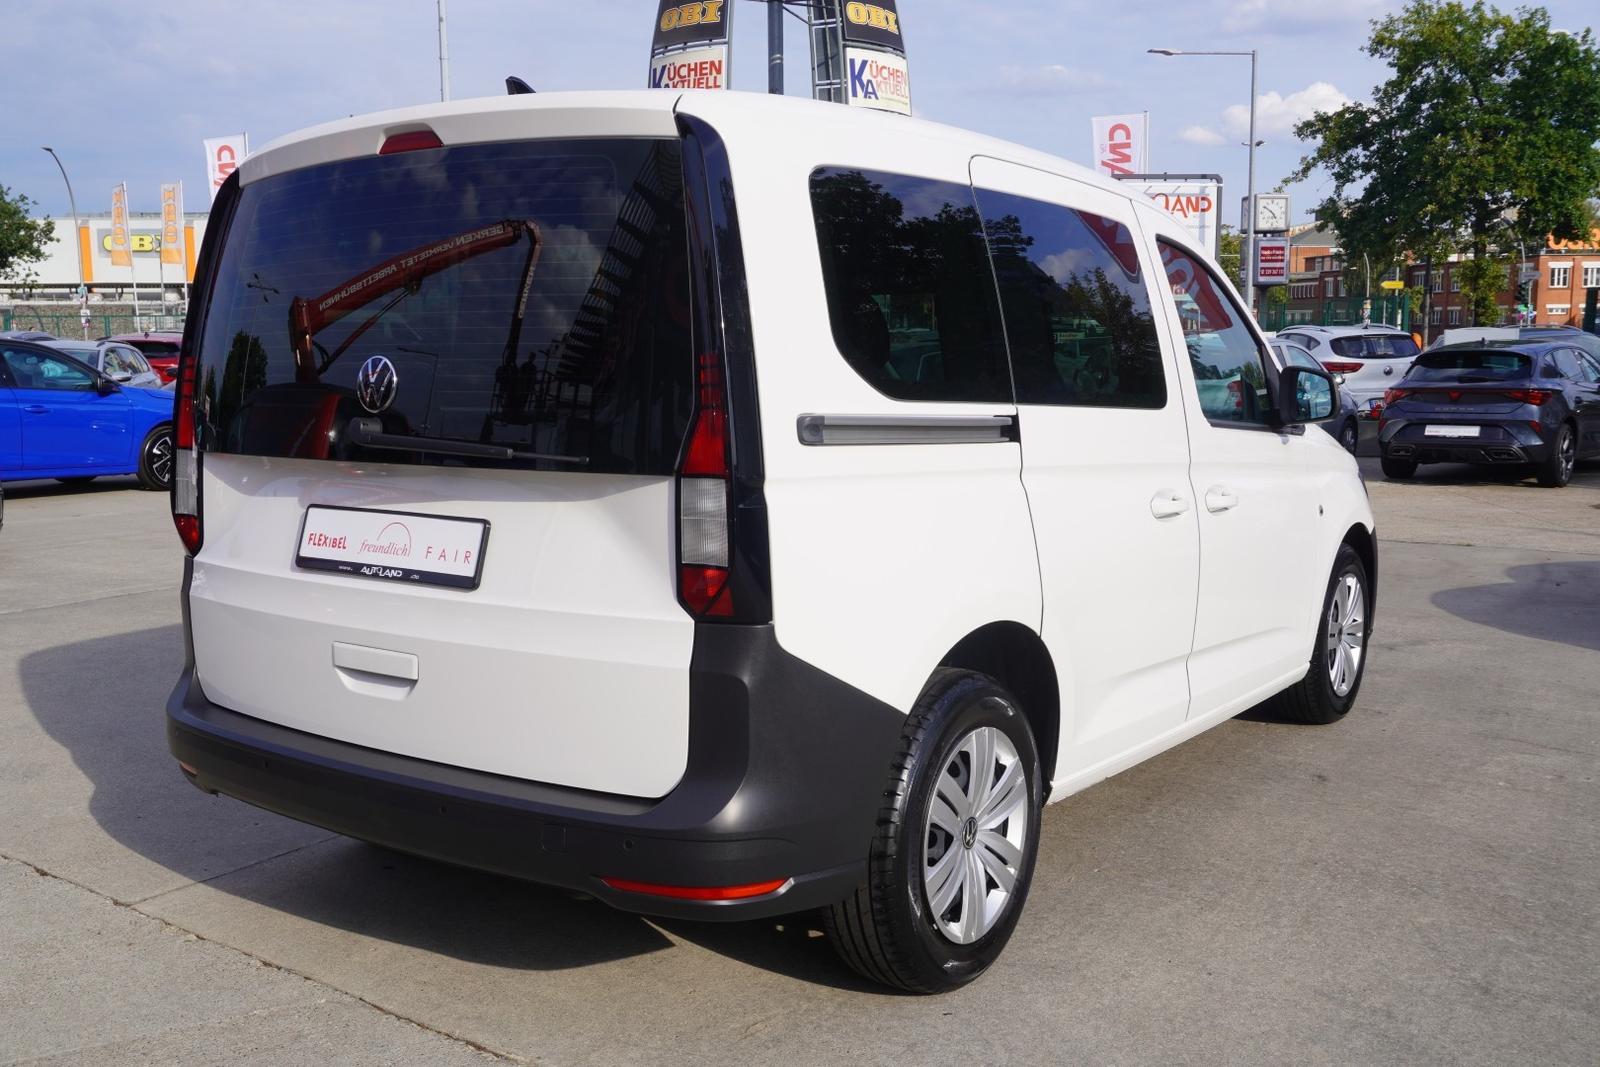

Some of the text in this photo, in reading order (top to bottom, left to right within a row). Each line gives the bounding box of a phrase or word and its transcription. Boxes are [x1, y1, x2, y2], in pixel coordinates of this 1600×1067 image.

[661, 0, 723, 31] OBI
[846, 2, 899, 34] OBI
[652, 60, 722, 88] KÜCHEN
[849, 58, 907, 97] KÜCHEN
[308, 532, 347, 550] FLEXIBEL
[357, 538, 410, 558] freundlich
[360, 566, 403, 578] AUTOLAND
